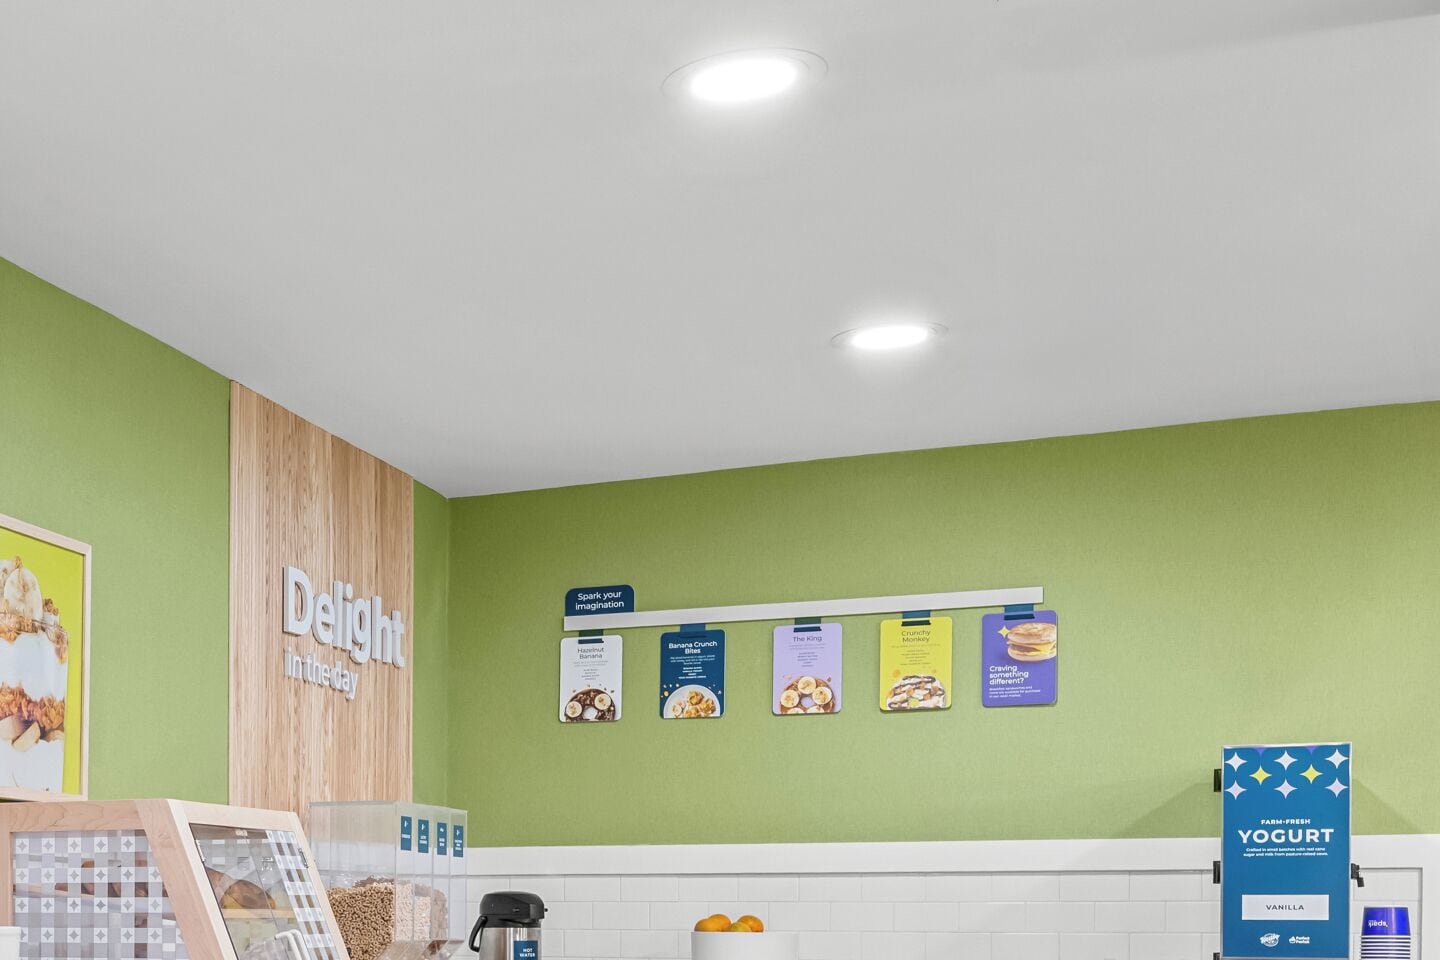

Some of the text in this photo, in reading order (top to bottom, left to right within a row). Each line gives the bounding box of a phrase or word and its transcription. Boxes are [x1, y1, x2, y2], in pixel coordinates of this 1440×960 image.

[577, 591, 622, 601] Spark your
[575, 600, 625, 611] imagination
[282, 565, 405, 668] Delight
[901, 629, 931, 637] Crunchy
[693, 640, 718, 648] Crunch
[684, 647, 702, 655] Bites
[989, 665, 1018, 673] Craving
[283, 646, 359, 702] in the day
[989, 671, 1029, 679] something
[989, 677, 1025, 685] different?
[1237, 828, 1335, 844] YOGURT
